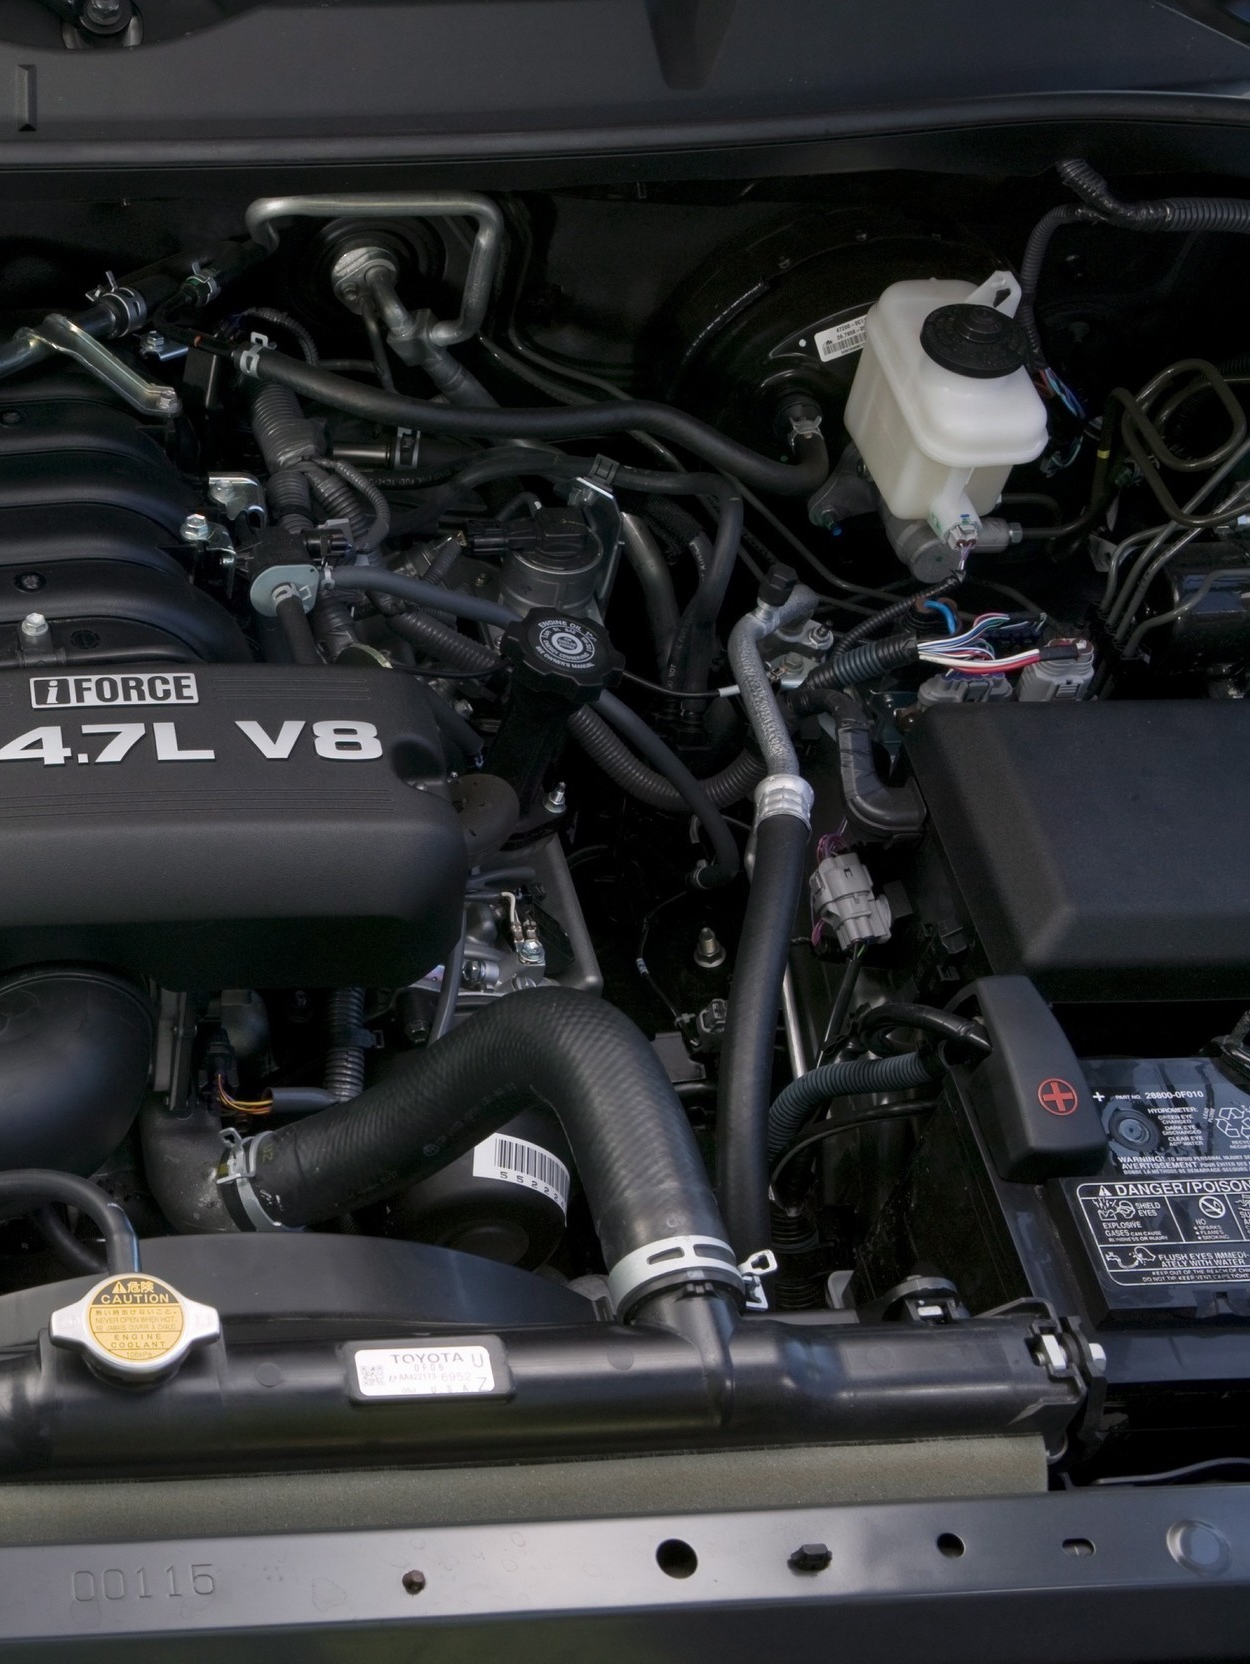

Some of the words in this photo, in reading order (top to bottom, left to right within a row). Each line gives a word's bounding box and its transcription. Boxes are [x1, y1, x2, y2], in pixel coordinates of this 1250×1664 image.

[235, 719, 383, 761] V8
[1122, 1161, 1197, 1169] AVERTISSEMENT
[1102, 1221, 1142, 1229] EXPLOSIVE
[1105, 1229, 1130, 1237] GASES
[1158, 1253, 1187, 1261] FLUSH
[1189, 1252, 1213, 1260] EYES
[1162, 1260, 1187, 1268] ATELY
[1189, 1259, 1212, 1267] WITH
[127, 1281, 154, 1293] 危険
[101, 1293, 169, 1304] CAUTION
[95, 1316, 118, 1324] NEVER
[140, 1315, 159, 1323] WHEN
[390, 1352, 464, 1364] TOYOTA
[472, 1353, 484, 1368] U
[72, 1564, 214, 1601] 00115
